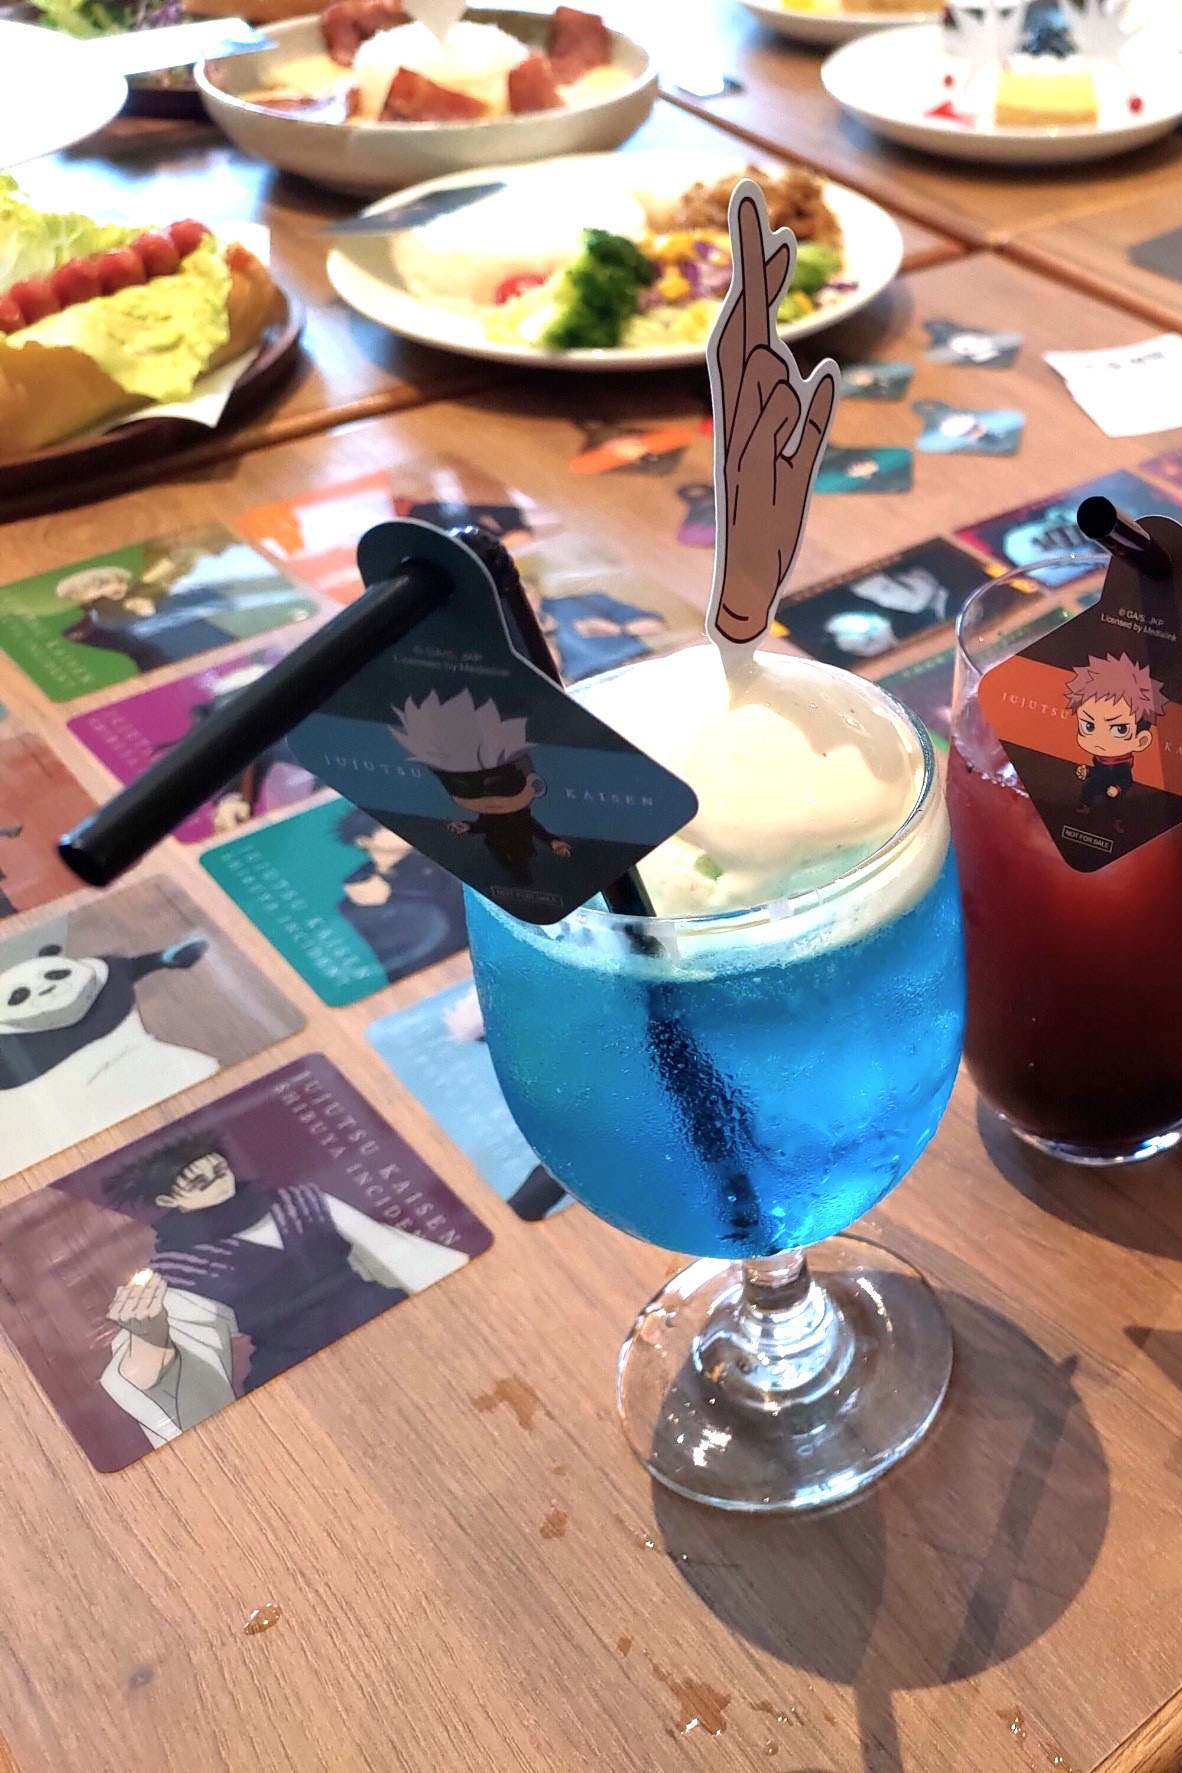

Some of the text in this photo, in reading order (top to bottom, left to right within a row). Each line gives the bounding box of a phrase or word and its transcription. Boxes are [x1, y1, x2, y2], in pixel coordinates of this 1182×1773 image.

[1100, 612, 1133, 630] Licensed
[1133, 622, 1143, 634] by
[1001, 691, 1071, 720] JUJUTSU
[323, 754, 655, 807] JUJUTSU KAISEN
[272, 1081, 347, 1159] SHIBUYA
[290, 1070, 380, 1156] JUJUTSU
[379, 1163, 462, 1245] KAISEN
